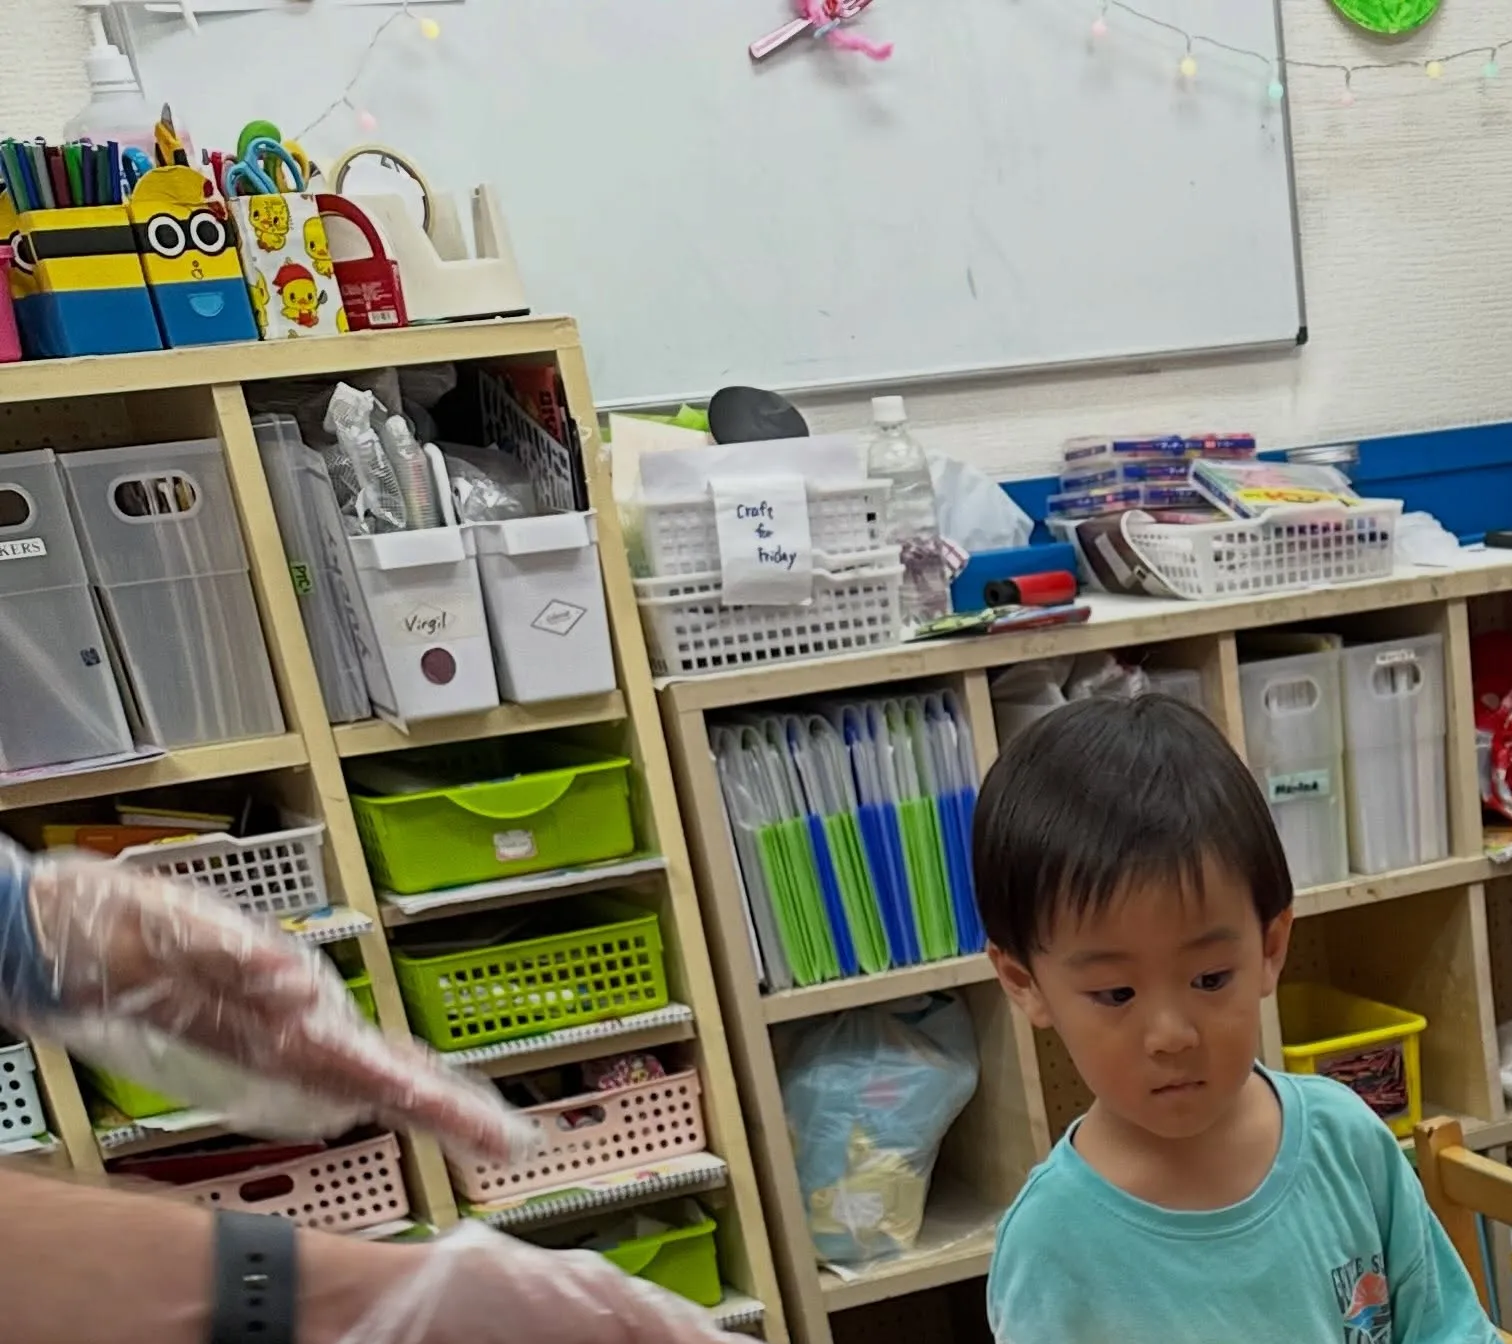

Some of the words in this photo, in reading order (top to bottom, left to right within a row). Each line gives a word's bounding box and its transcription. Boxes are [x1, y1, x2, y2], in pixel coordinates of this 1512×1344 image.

[755, 522, 774, 539] for
[757, 544, 797, 570] Friday
[404, 611, 448, 634] Virgil
